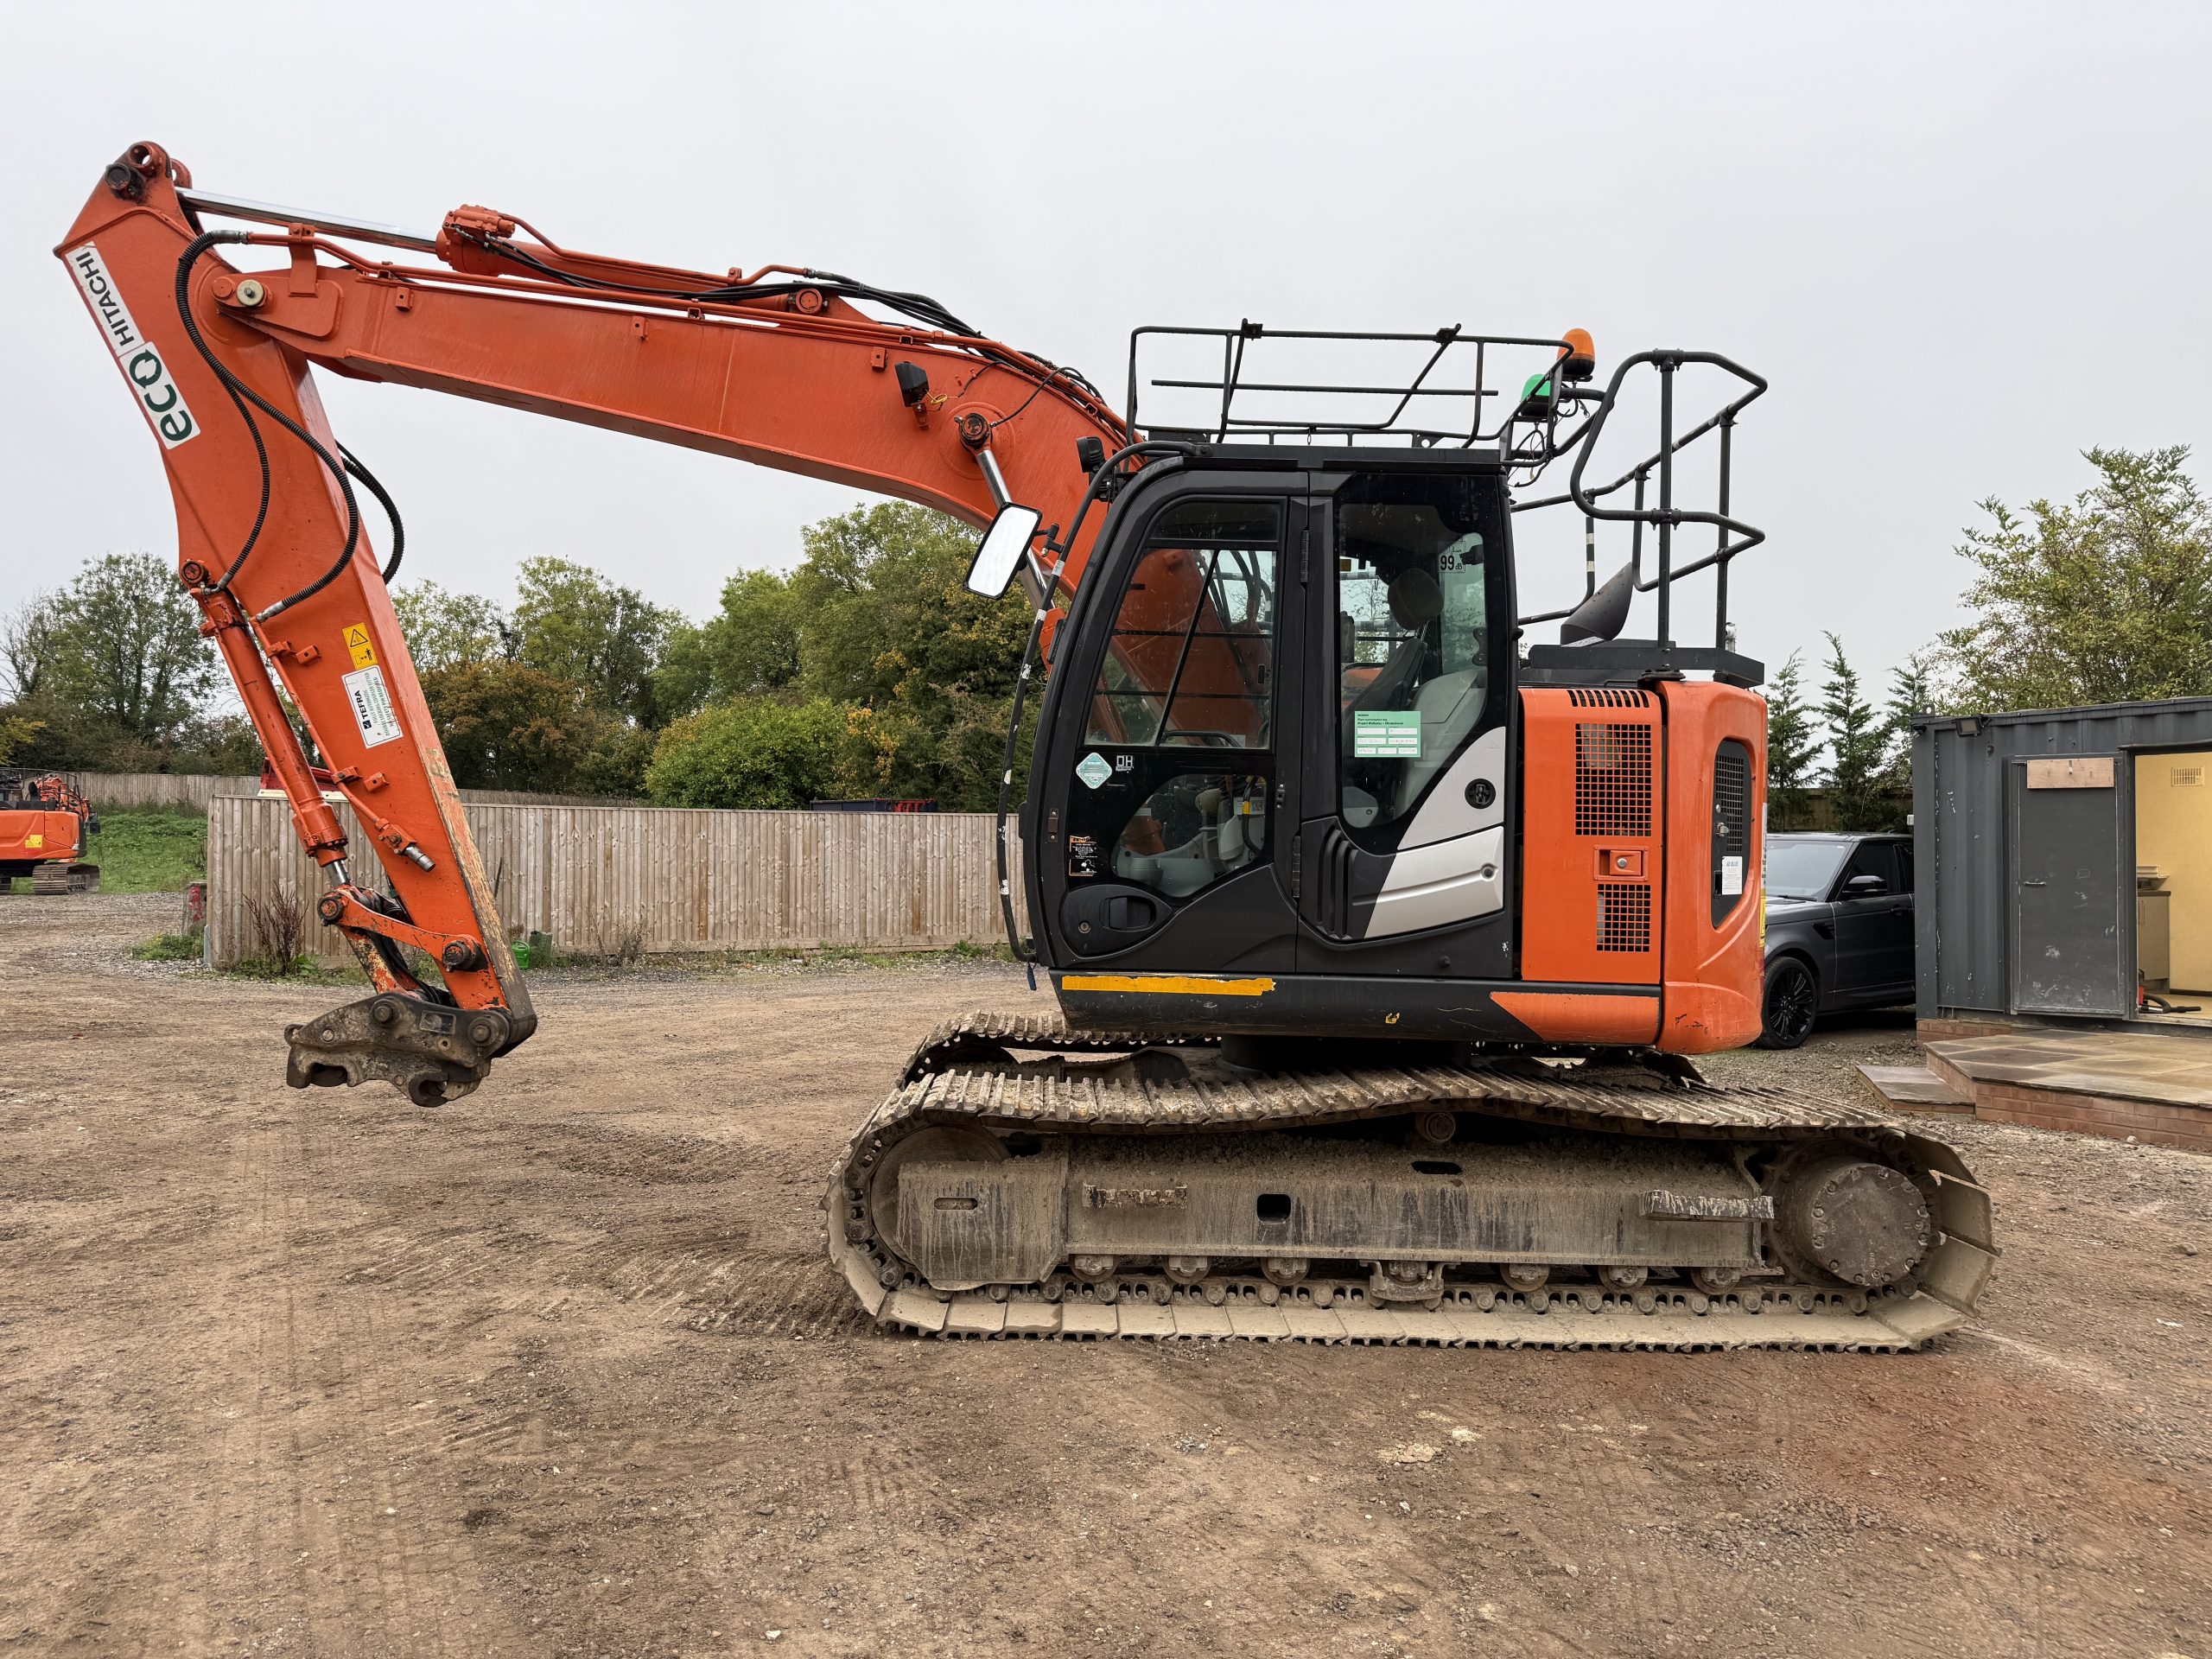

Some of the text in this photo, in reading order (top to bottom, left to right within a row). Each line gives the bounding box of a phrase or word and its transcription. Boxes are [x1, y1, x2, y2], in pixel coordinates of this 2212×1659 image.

[76, 251, 134, 346] HITACHI
[1440, 556, 1454, 570] 99
[354, 690, 368, 719] TEFRA
